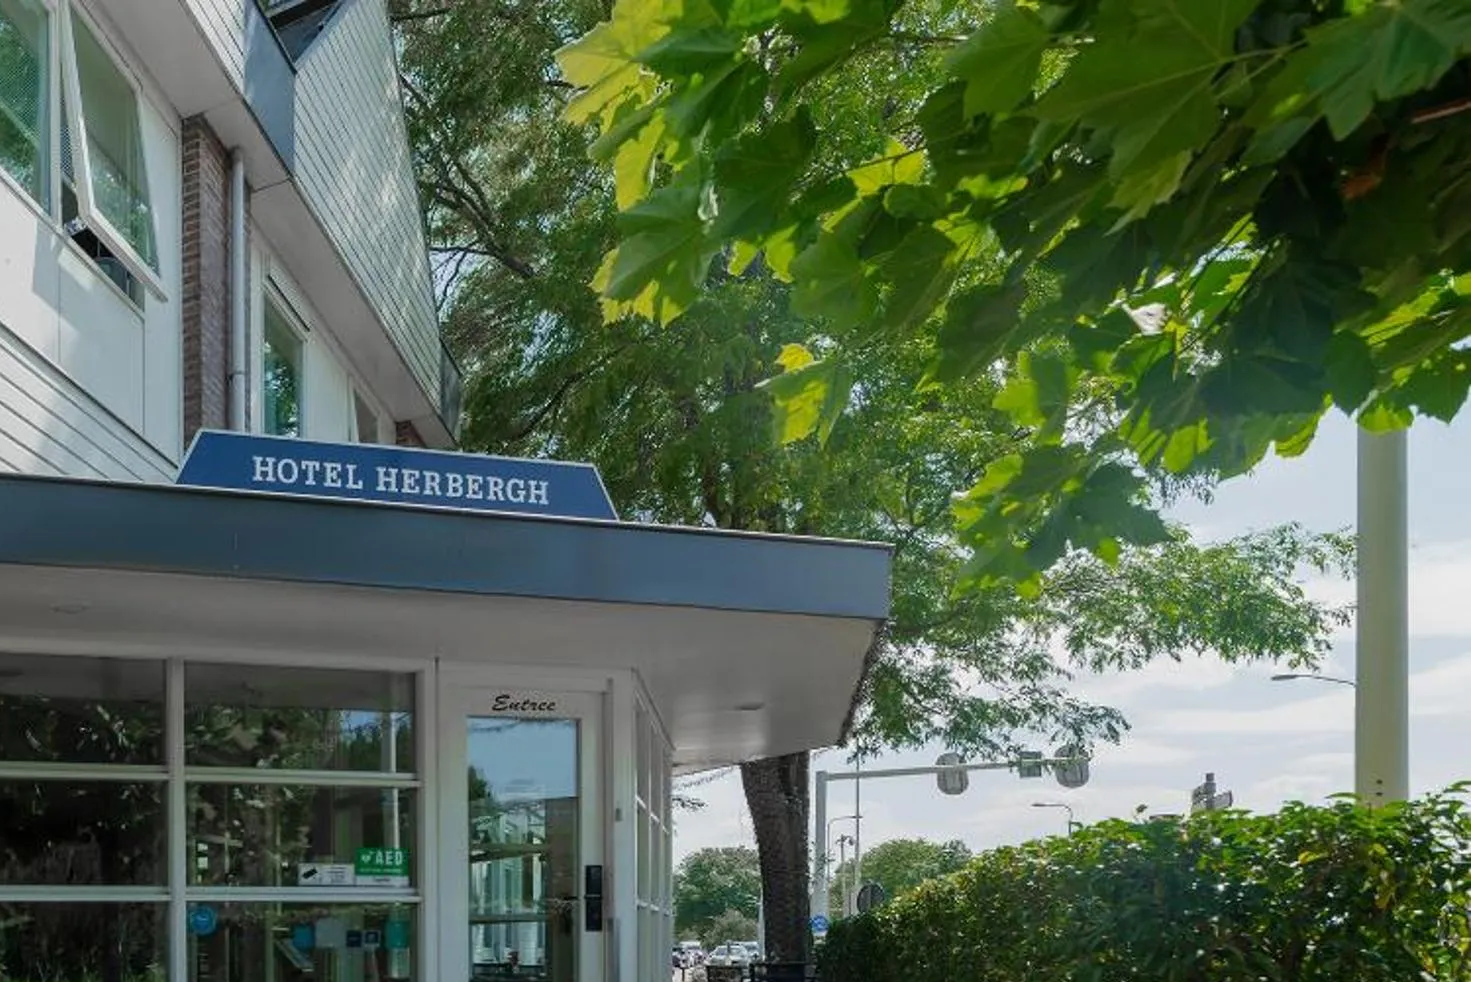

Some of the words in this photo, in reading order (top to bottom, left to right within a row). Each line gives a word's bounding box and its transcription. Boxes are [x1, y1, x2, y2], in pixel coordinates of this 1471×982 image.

[252, 456, 363, 490] HOTEL
[376, 466, 550, 505] HERBERGH
[491, 694, 556, 711] Entree
[375, 850, 403, 866] AED
